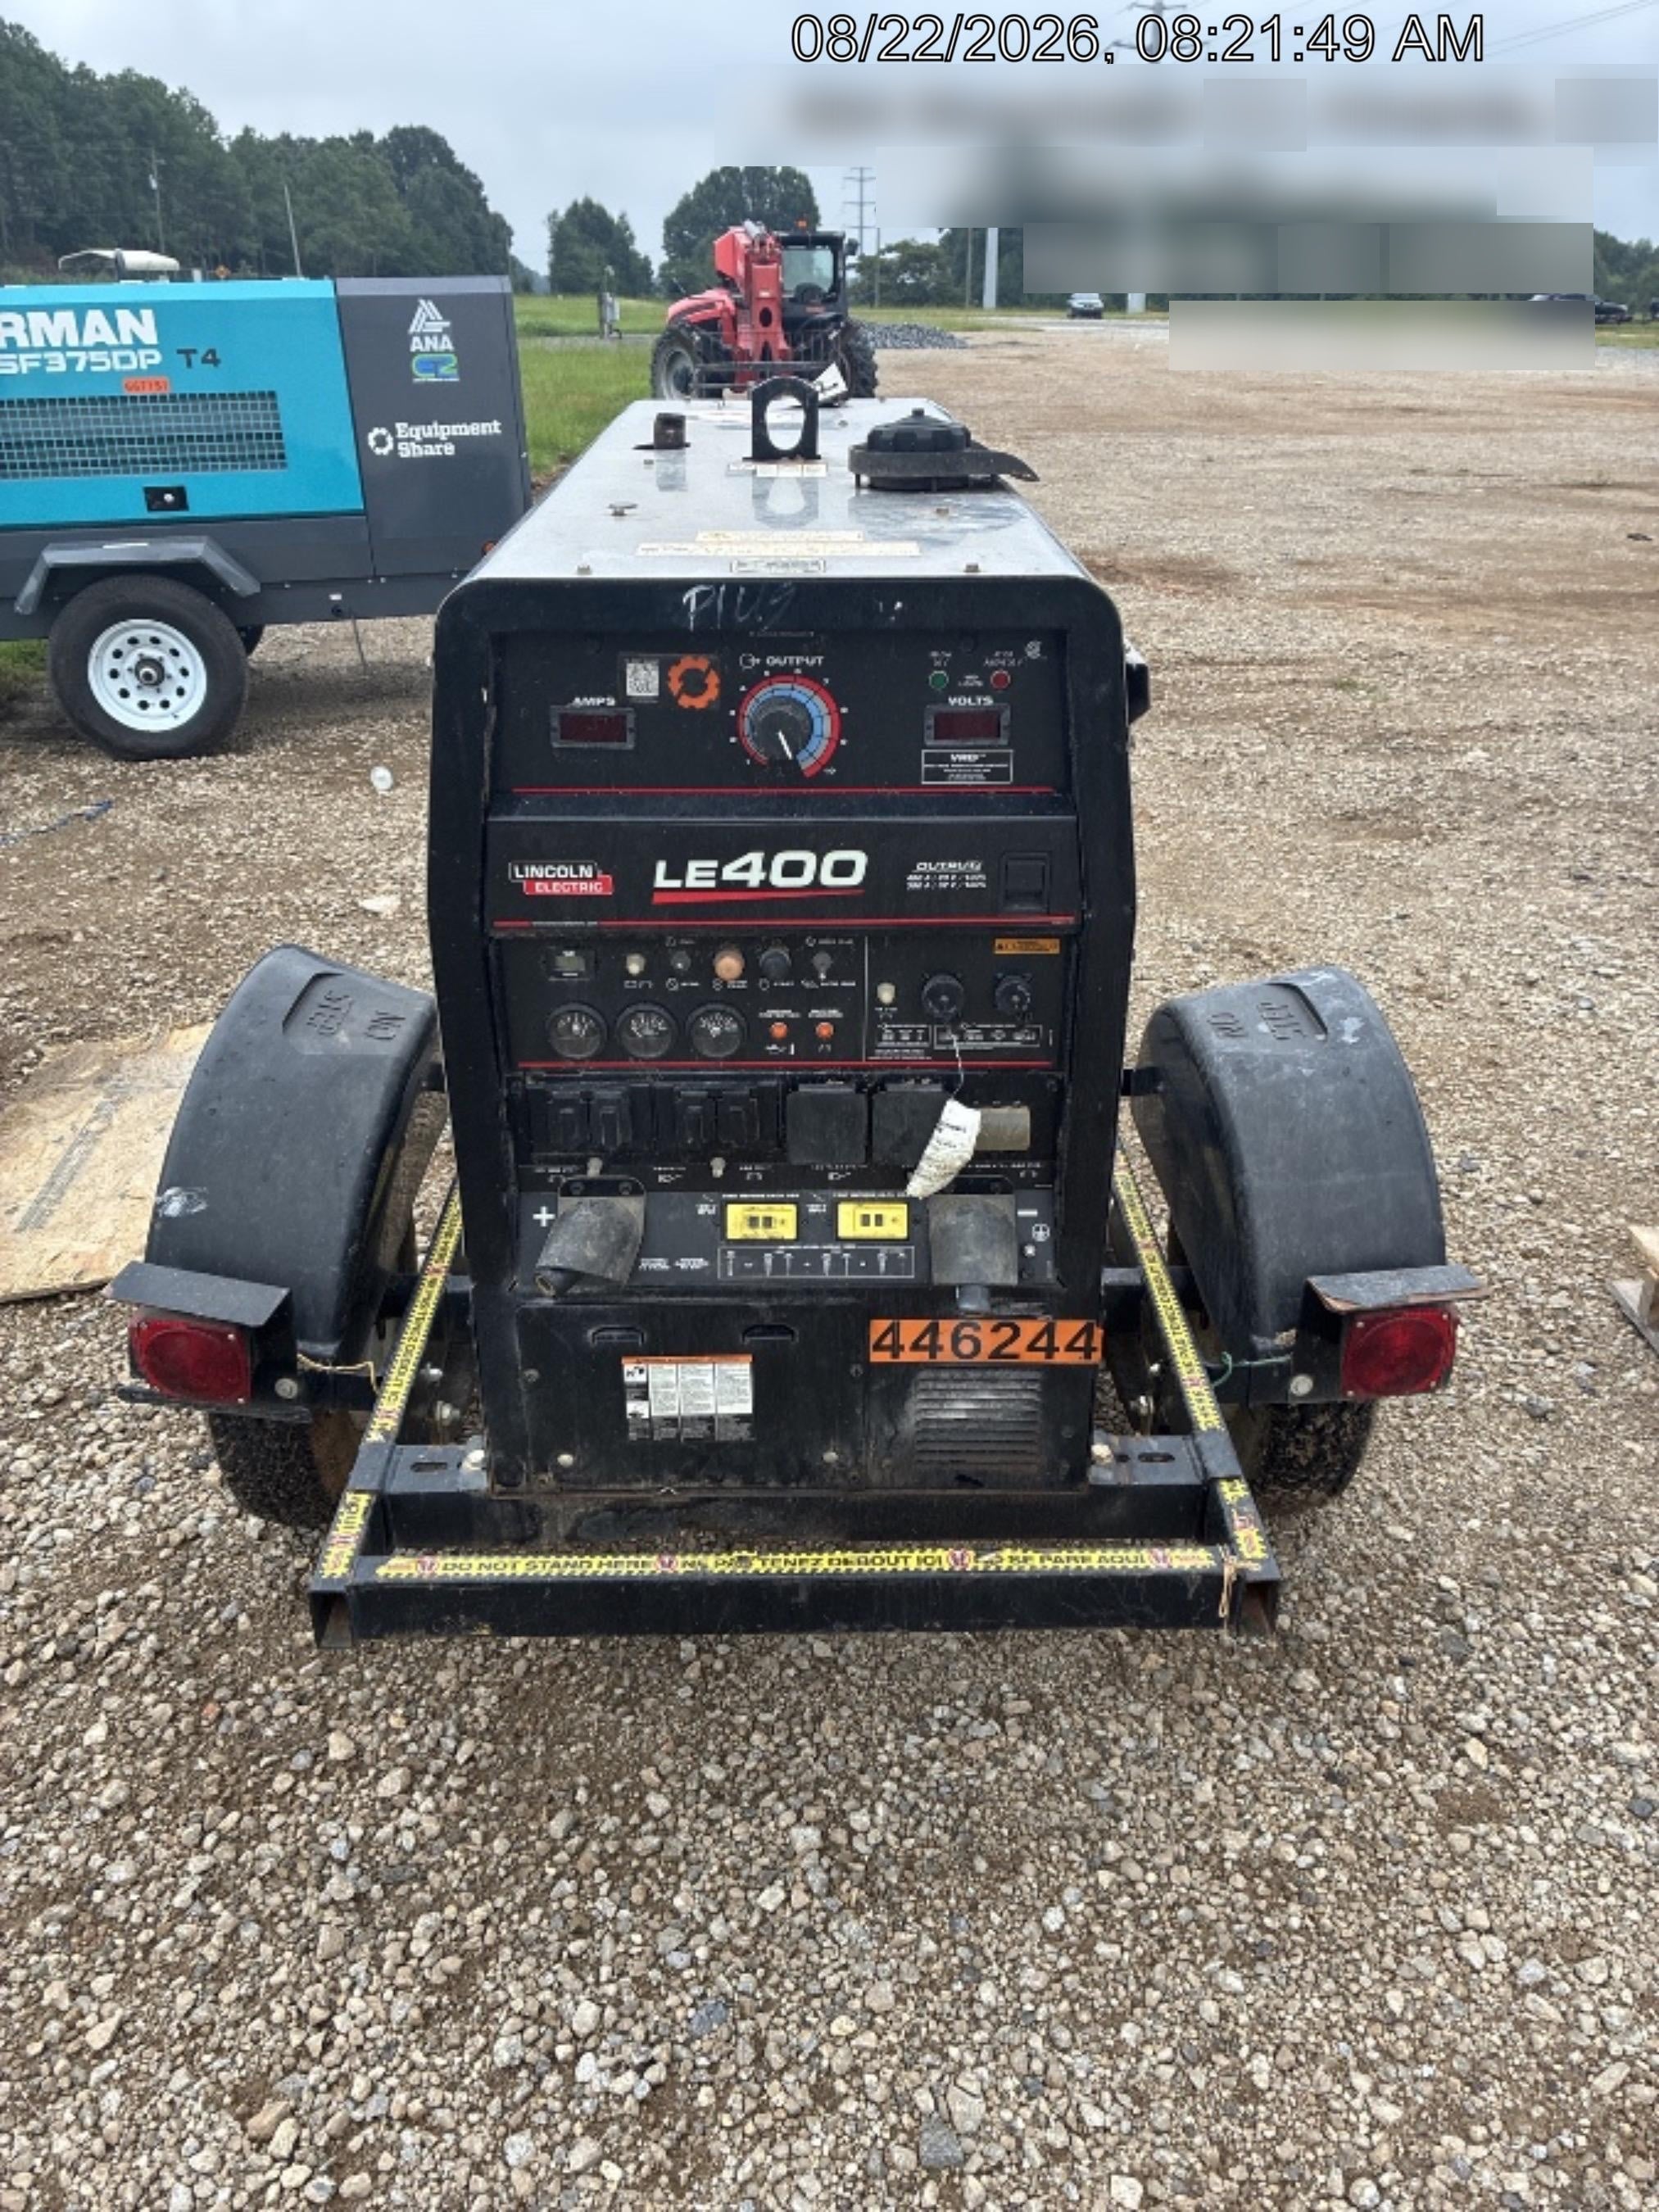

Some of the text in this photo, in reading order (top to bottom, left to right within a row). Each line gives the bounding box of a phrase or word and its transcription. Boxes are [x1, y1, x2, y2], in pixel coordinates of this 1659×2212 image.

[410, 335, 455, 352] ANA
[395, 419, 502, 442] Equipment
[397, 442, 456, 458] Share
[766, 656, 824, 666] OUTPUT
[573, 697, 616, 706] AMPS
[948, 696, 994, 706] VOLTS
[514, 863, 593, 879] LINCOLN
[653, 850, 868, 889] LE400
[534, 882, 603, 893] ELECTRIC
[872, 1321, 1097, 1360] 446244
[442, 1558, 653, 1571] DO NOT STAND HERE
